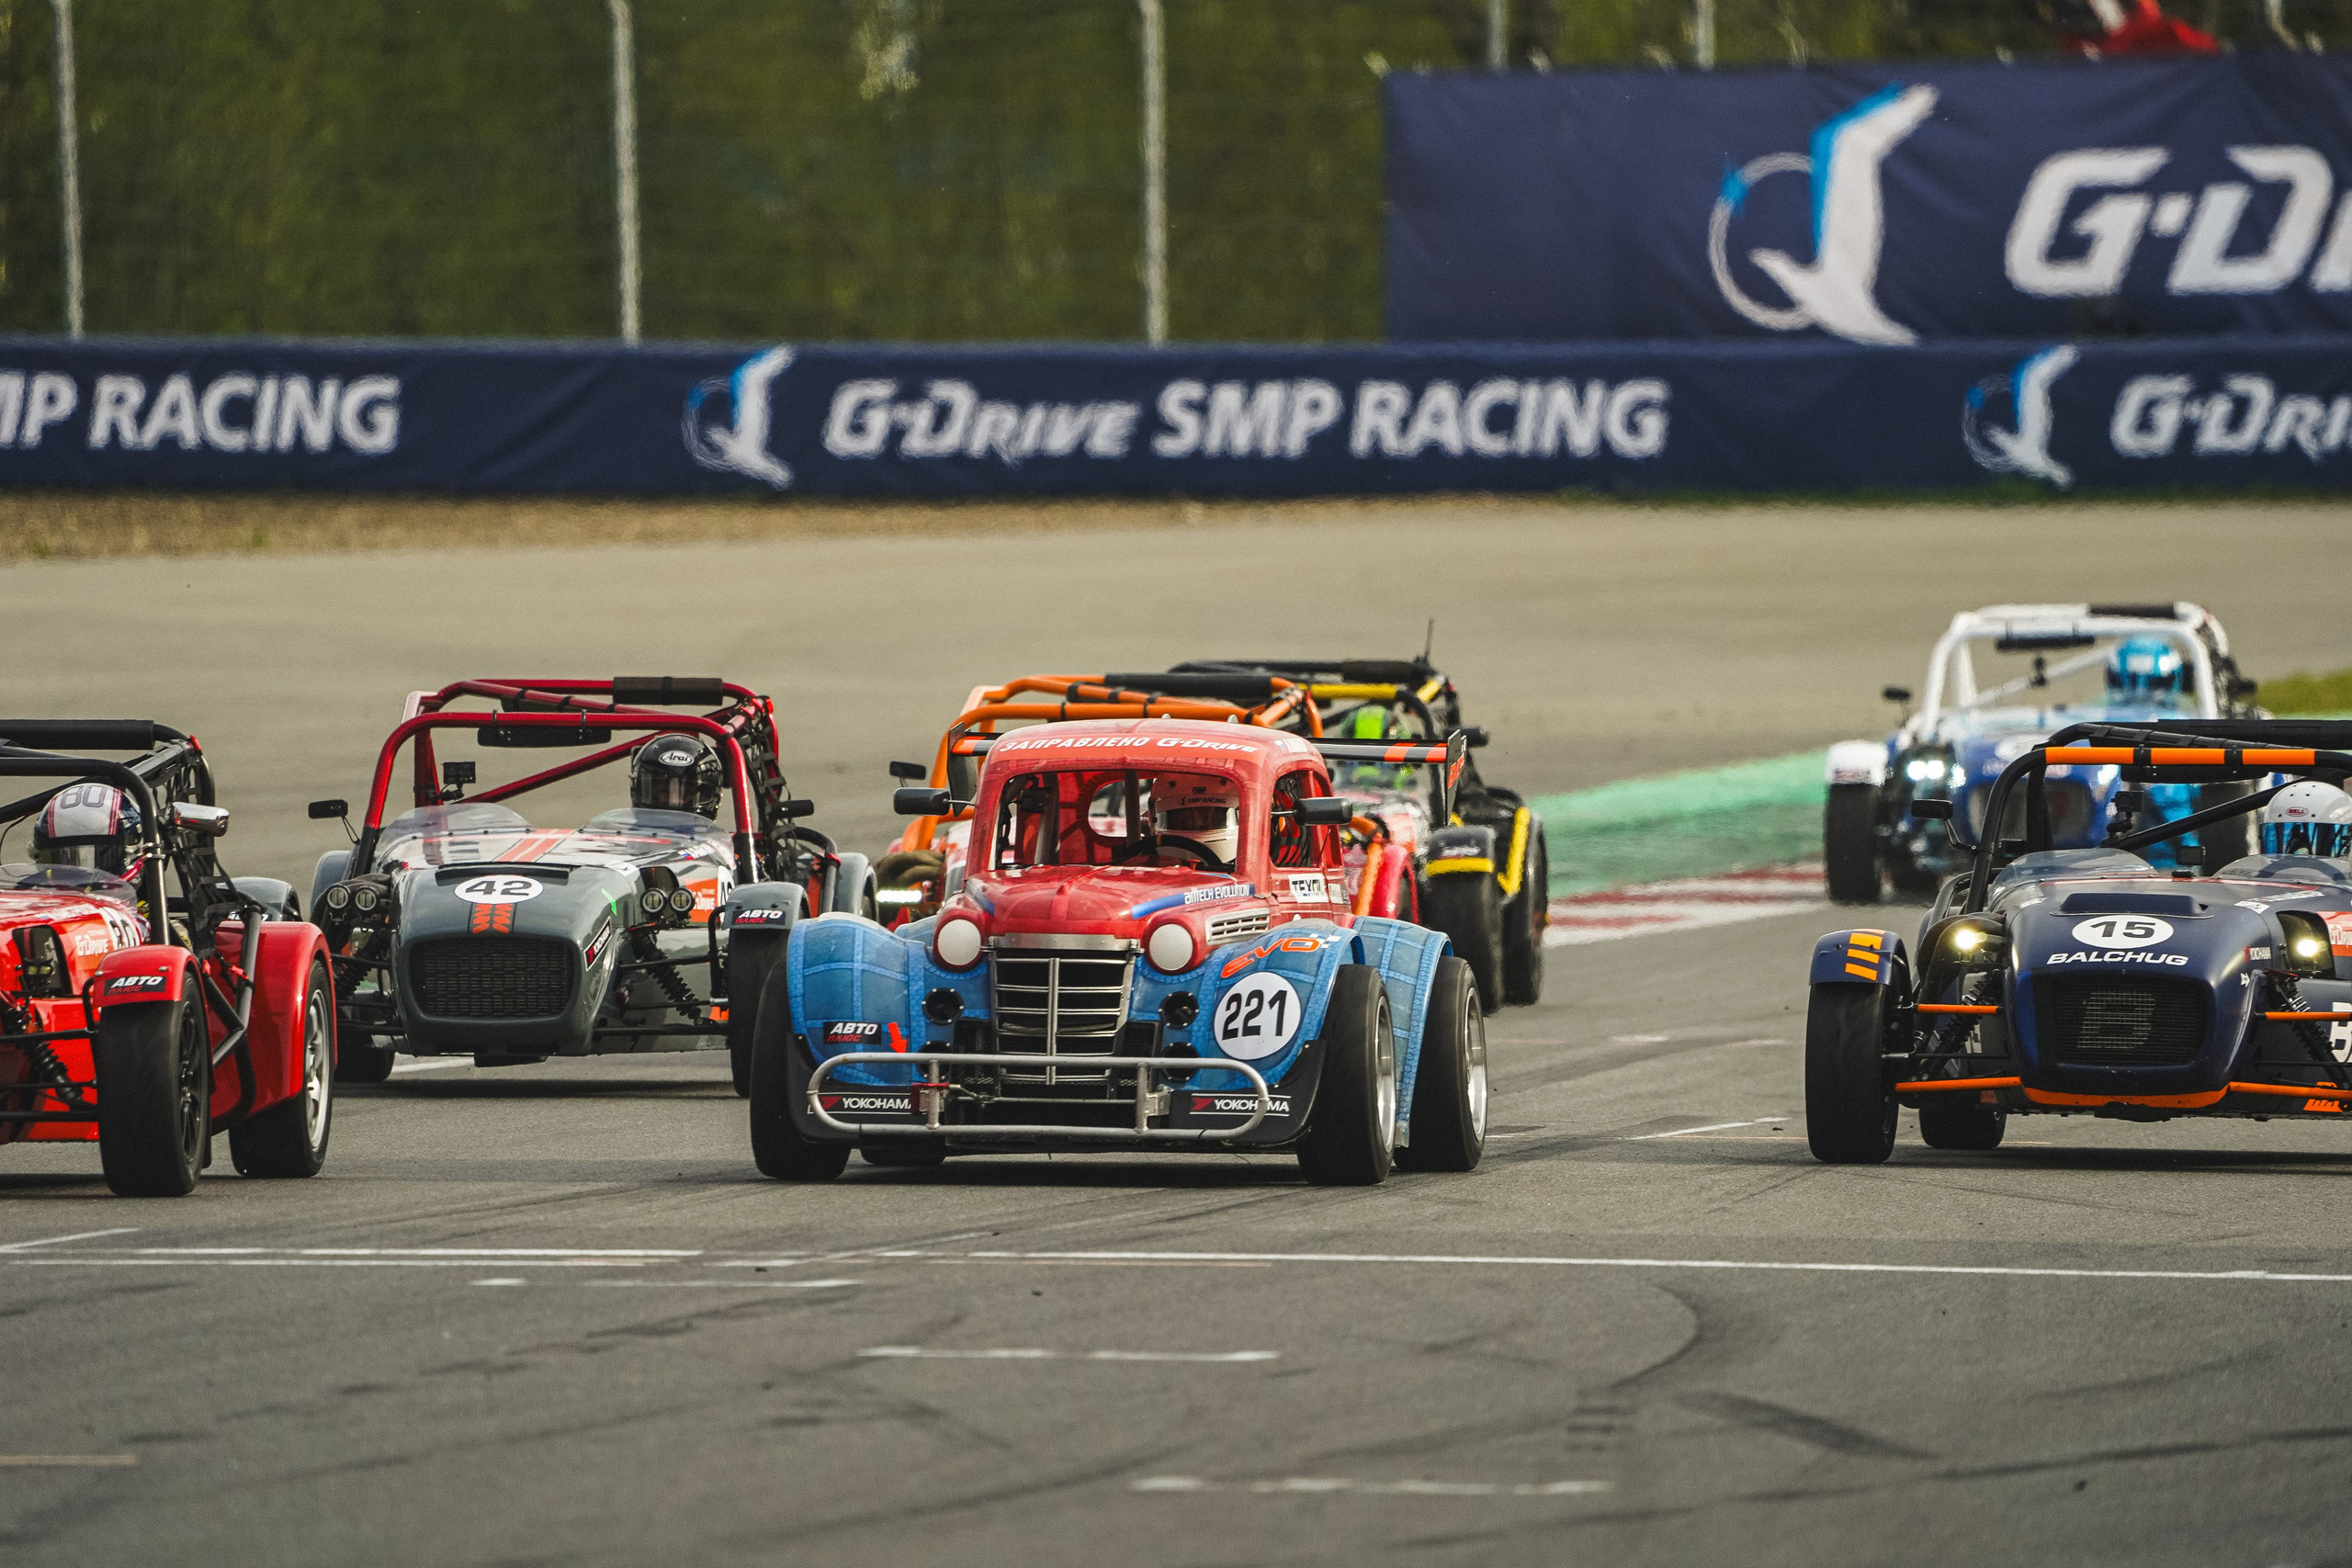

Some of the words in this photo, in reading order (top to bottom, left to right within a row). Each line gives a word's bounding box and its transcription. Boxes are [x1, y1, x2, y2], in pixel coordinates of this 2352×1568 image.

[88, 374, 401, 455] RACING
[1151, 378, 1343, 458] SMP
[1350, 378, 1668, 458] RACING
[1000, 737, 1150, 752] ЗАПРАВЛЕНО
[668, 752, 688, 761] Arai
[466, 881, 532, 896] 42
[739, 909, 784, 919] АВТО
[2090, 921, 2156, 939] 15
[1221, 937, 1320, 979] EVO
[2046, 951, 2190, 966] BALCHUG
[110, 976, 164, 988] АВТО
[1222, 989, 1288, 1041] 221
[830, 1022, 878, 1035] АВТО
[842, 1098, 911, 1109] YOKOHAM
[1215, 1100, 1290, 1112] YOKOHMA
